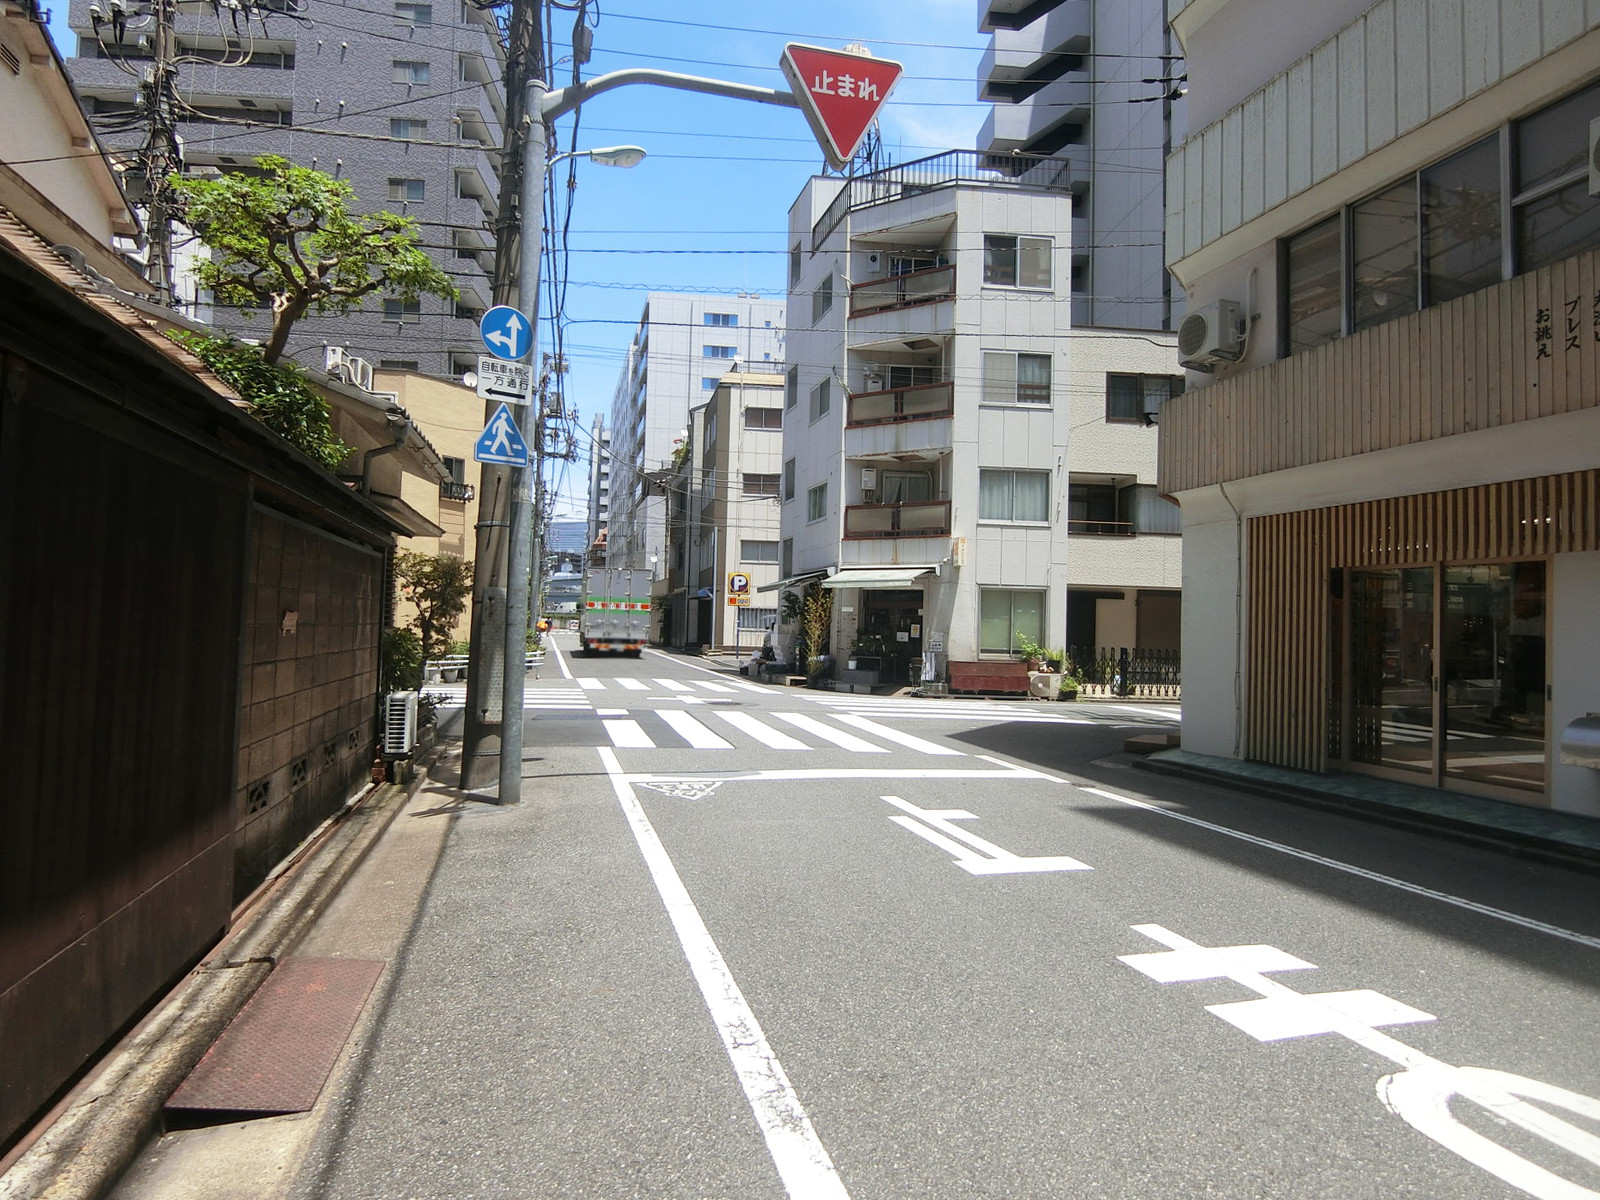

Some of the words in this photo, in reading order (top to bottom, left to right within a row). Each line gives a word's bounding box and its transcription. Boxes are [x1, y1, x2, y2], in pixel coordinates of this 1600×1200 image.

[811, 69, 880, 102] 止まれ
[1564, 295, 1581, 352] プレス
[481, 361, 530, 378] 自転車を除く
[481, 376, 530, 391] 一方通行
[733, 575, 747, 591] P
